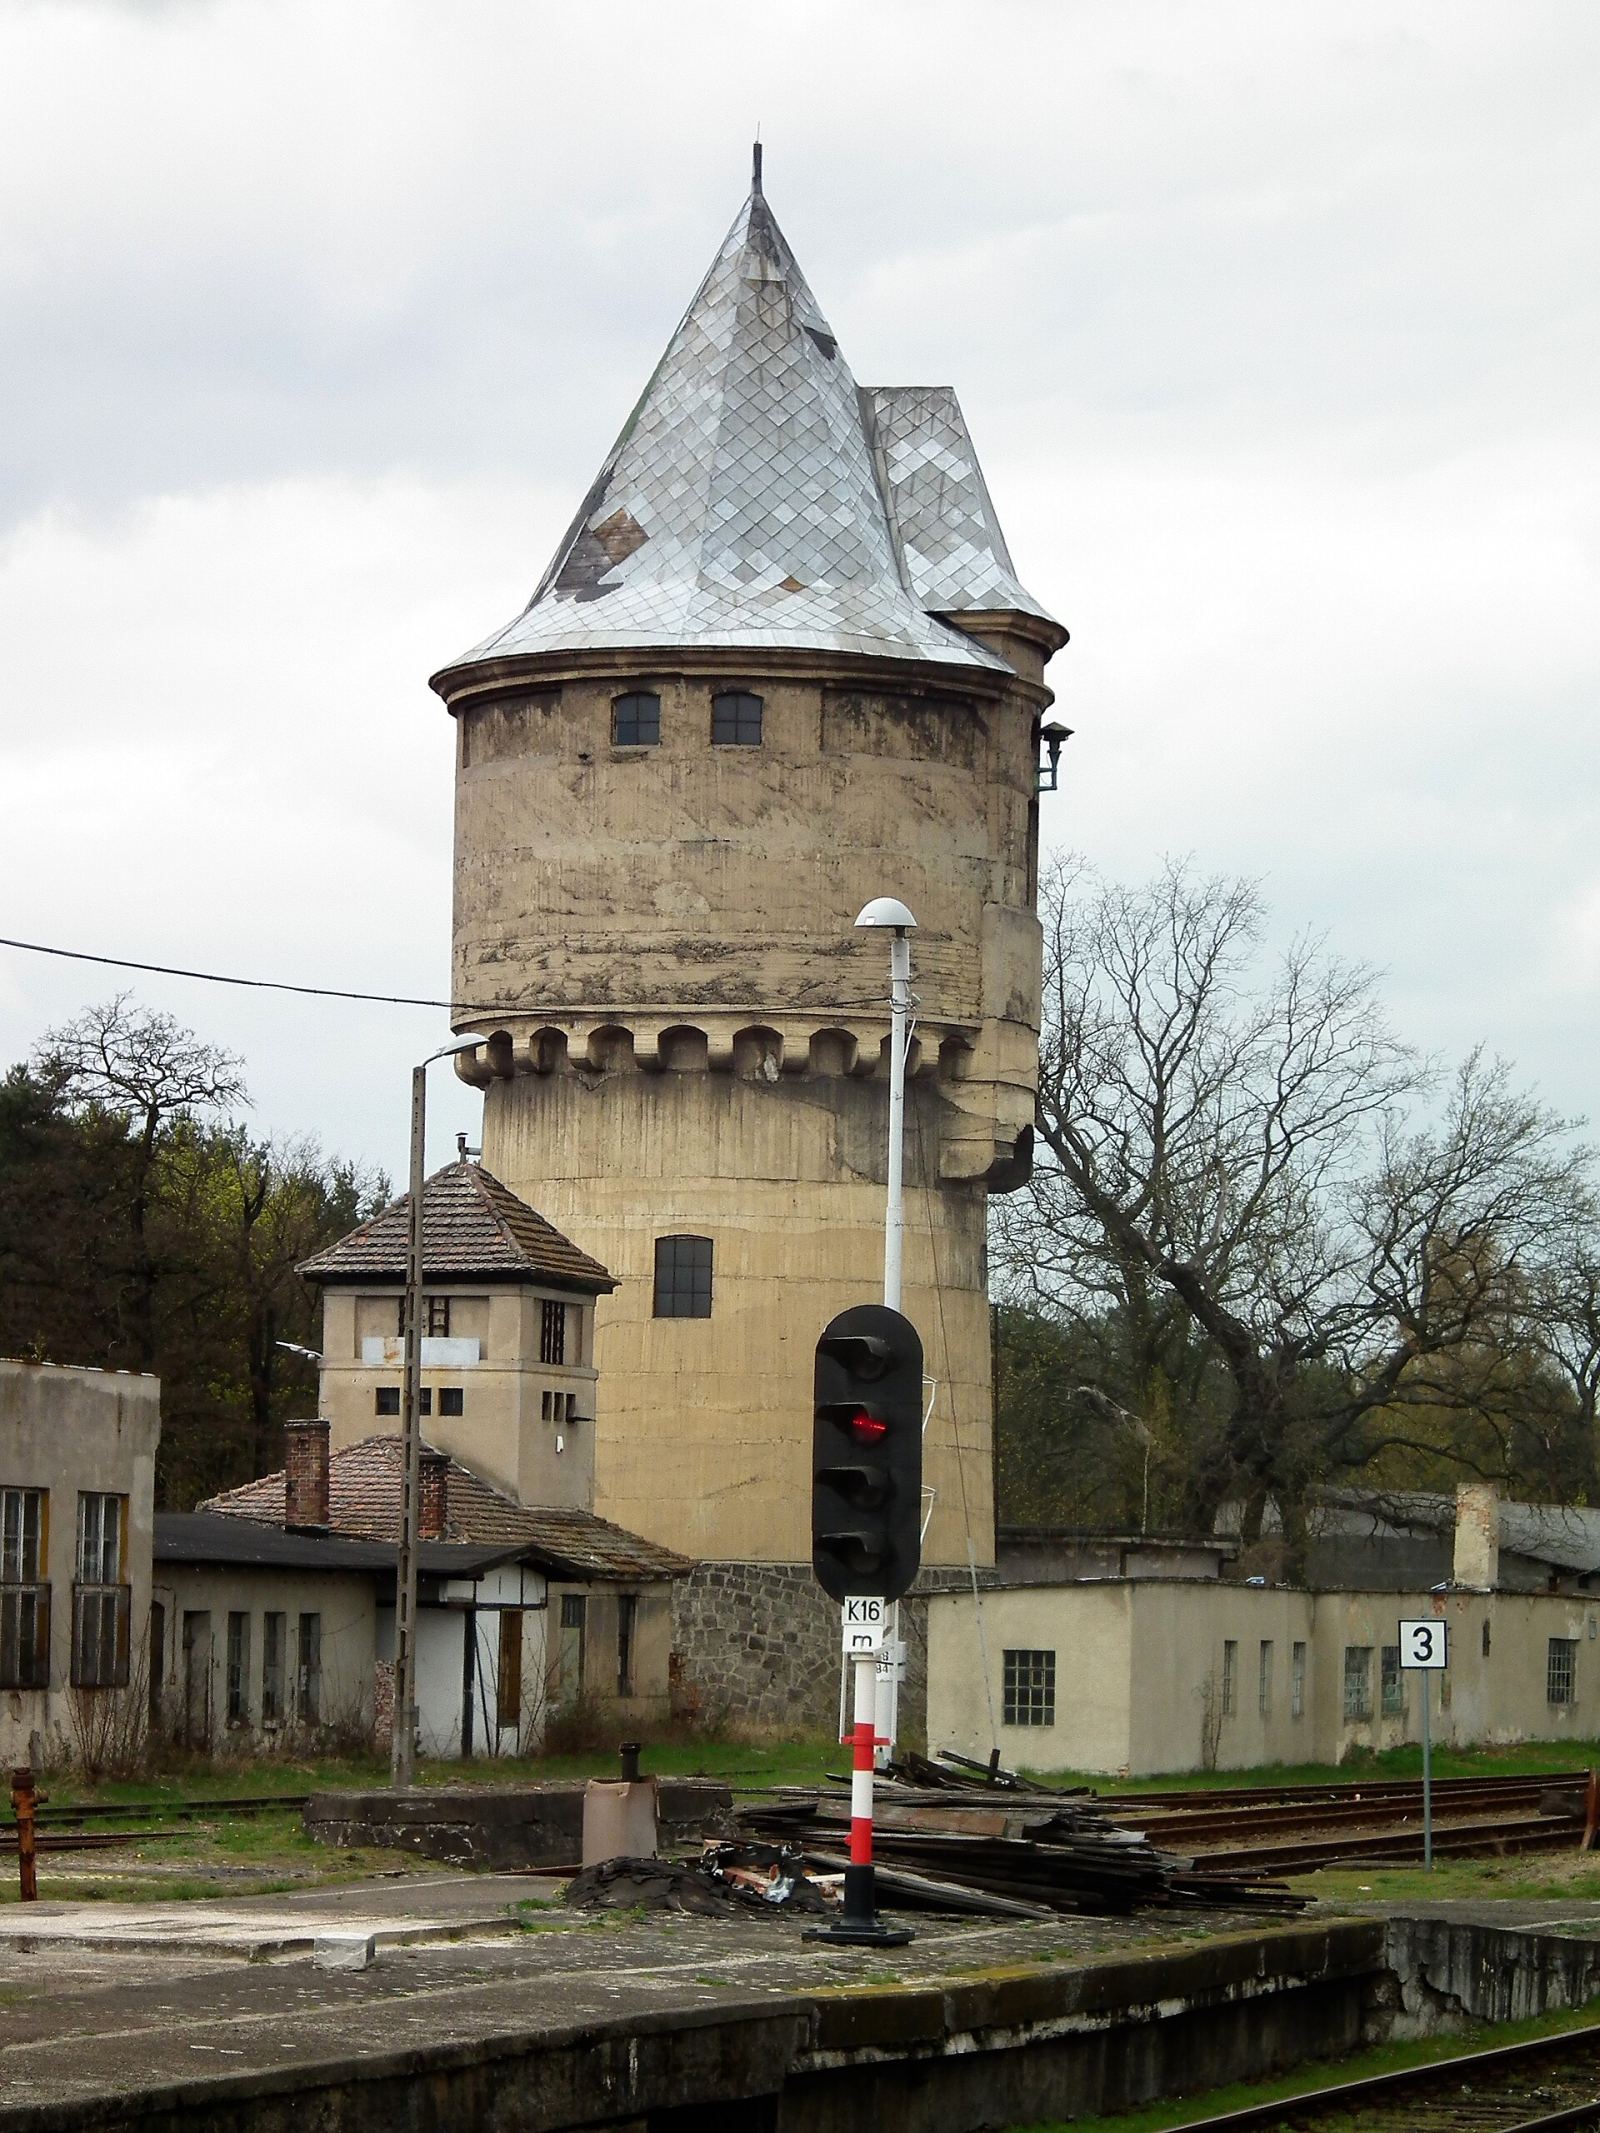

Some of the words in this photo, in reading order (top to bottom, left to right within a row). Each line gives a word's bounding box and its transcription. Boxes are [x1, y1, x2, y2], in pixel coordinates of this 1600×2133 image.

[848, 1600, 880, 1621] K16
[852, 1635, 872, 1647] m
[1413, 1626, 1433, 1661] 3
